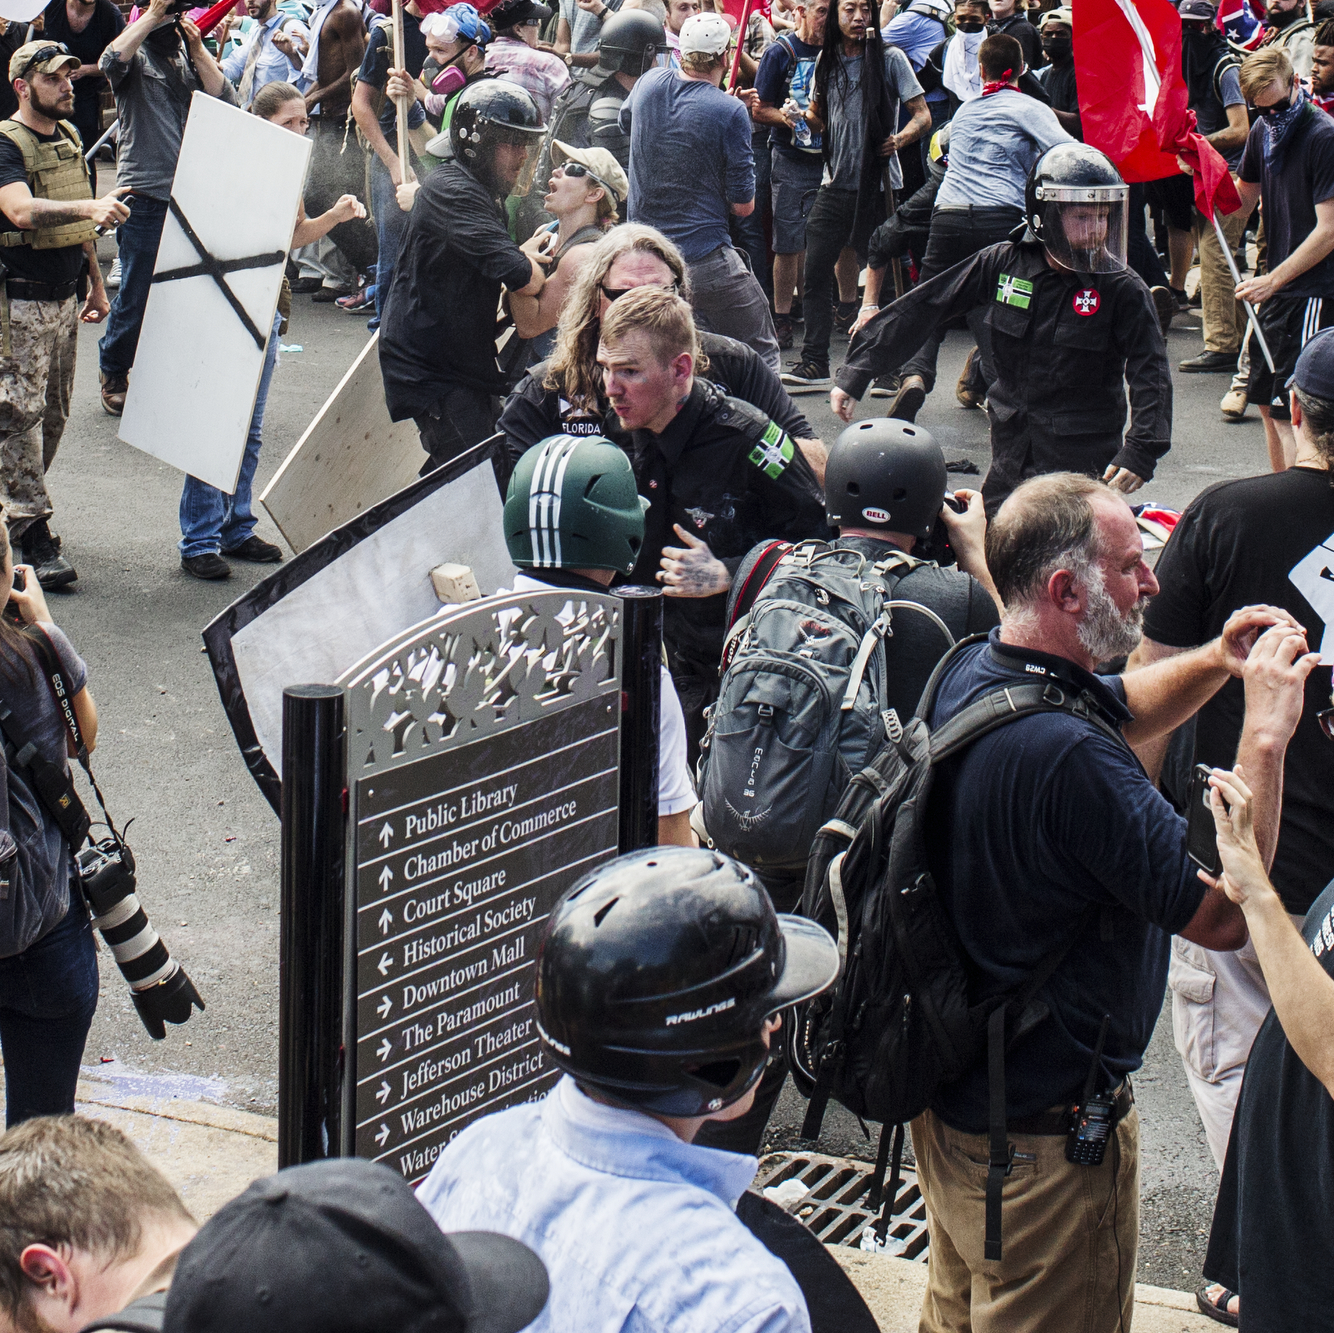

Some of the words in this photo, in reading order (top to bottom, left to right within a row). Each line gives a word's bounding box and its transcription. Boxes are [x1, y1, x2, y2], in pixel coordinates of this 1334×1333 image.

[562, 422, 601, 435] FLORIDA
[867, 510, 887, 520] BELL
[51, 673, 65, 698] EOS
[61, 699, 78, 742] DIGITAL
[404, 839, 479, 880] Chamber
[482, 827, 499, 852] of
[500, 800, 577, 844] Commerce
[405, 804, 457, 839] Public
[460, 783, 518, 819] Library
[404, 889, 451, 923] Court
[454, 869, 506, 907] Square
[404, 915, 482, 967] Historical
[484, 897, 536, 933] Society
[403, 957, 488, 1010] Downtown
[492, 935, 525, 971] Mall
[402, 1022, 433, 1052] The
[436, 981, 520, 1036] Paramount
[665, 997, 736, 1026] RAWLINGS
[400, 1048, 471, 1100] Jefferson
[474, 1018, 533, 1059] Theater
[401, 1082, 485, 1135] Warehouse
[488, 1050, 544, 1094] District
[400, 1140, 446, 1177] Water
